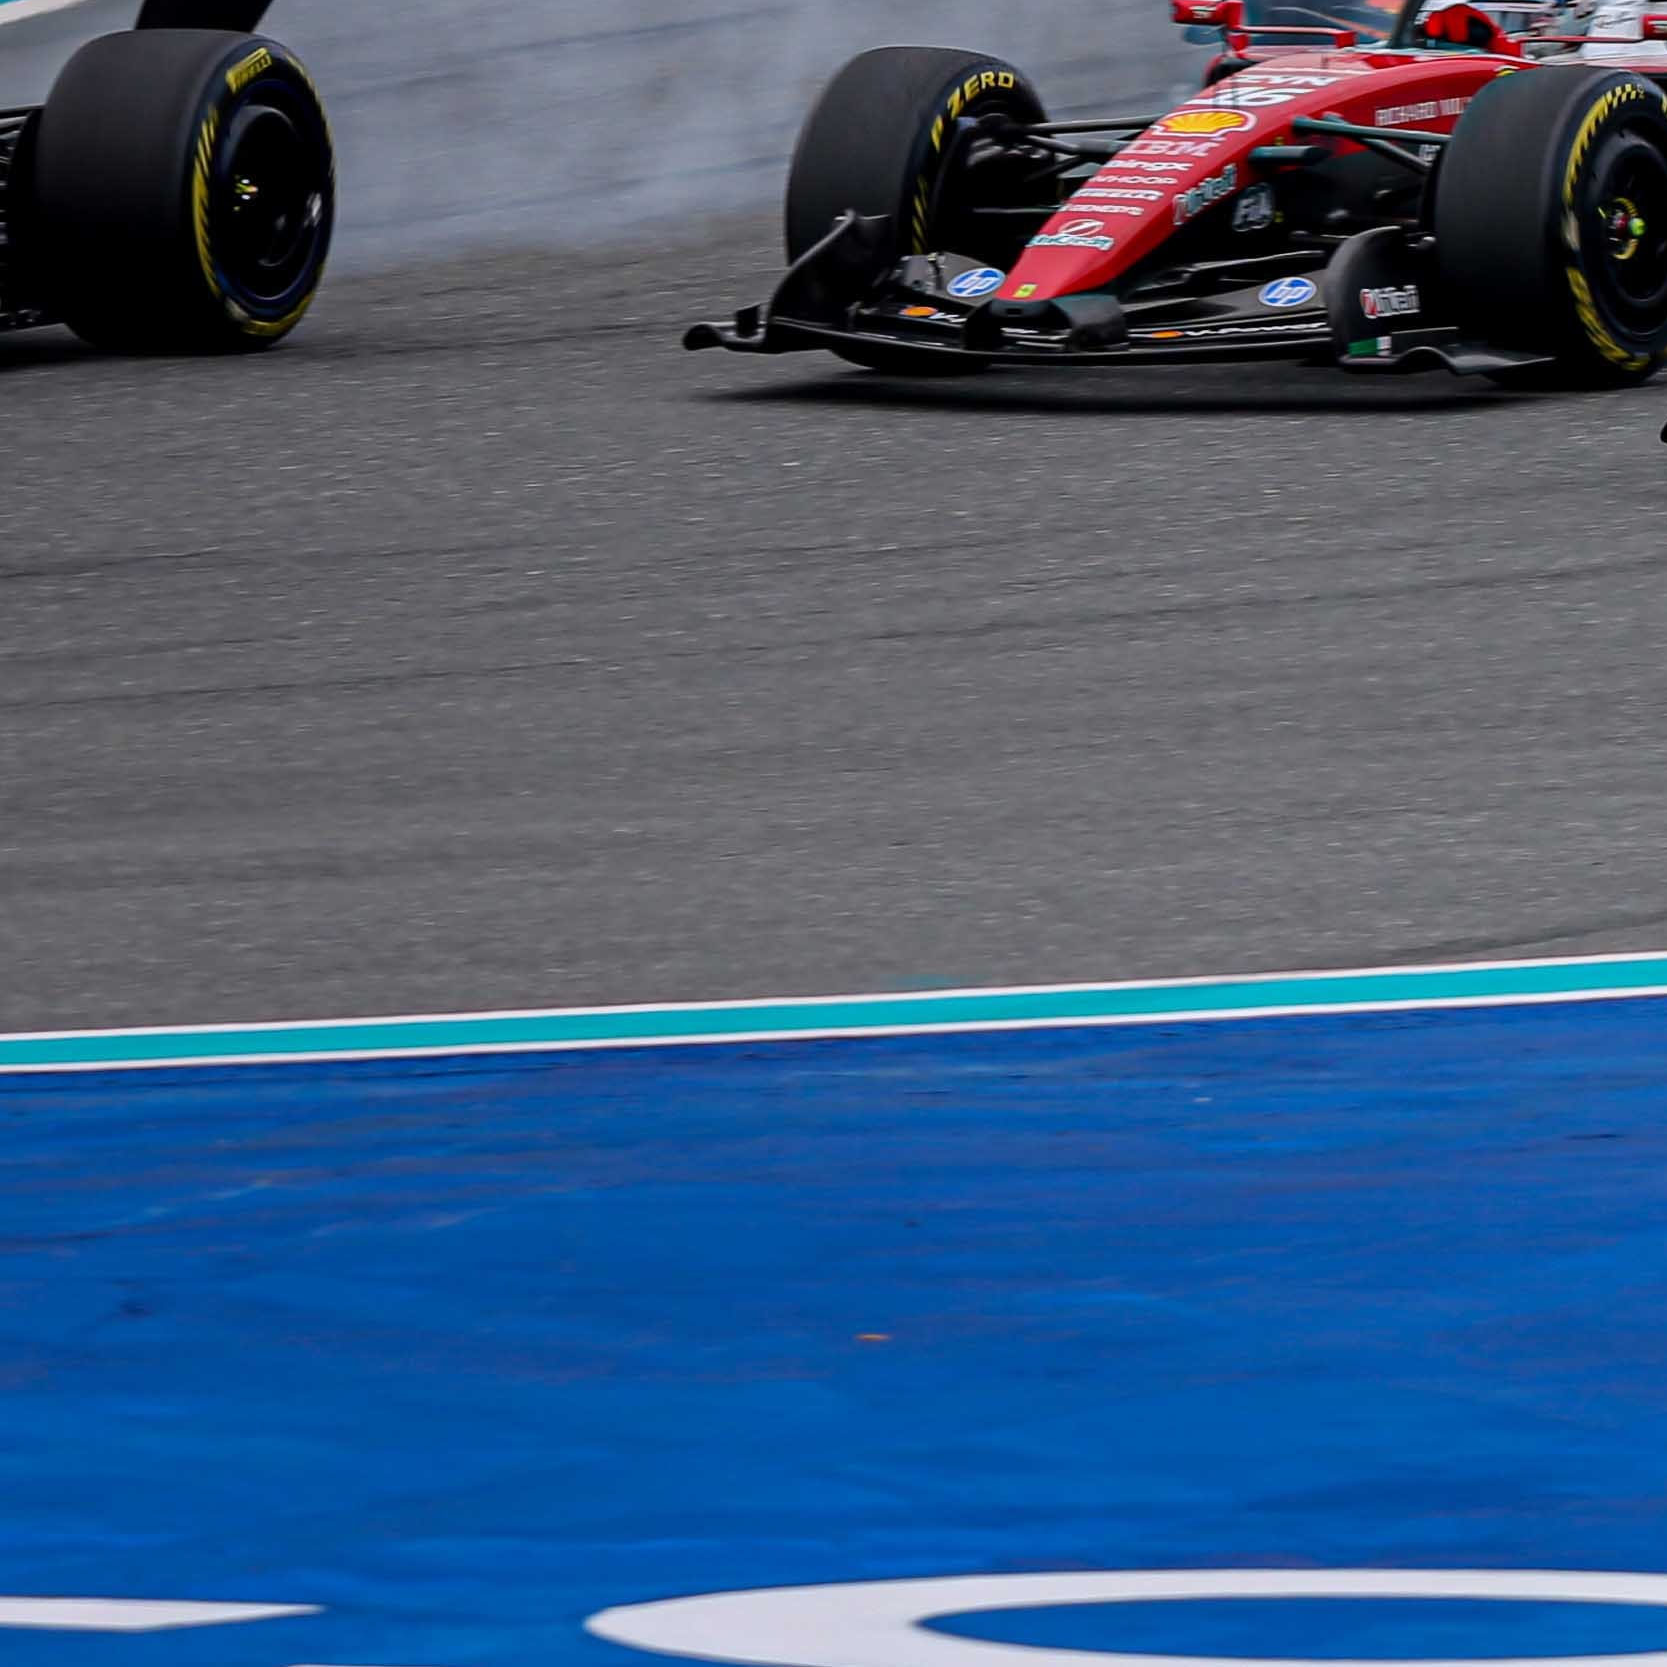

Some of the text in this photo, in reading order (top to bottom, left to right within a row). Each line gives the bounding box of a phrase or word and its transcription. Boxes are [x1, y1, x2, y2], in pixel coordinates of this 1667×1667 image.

[947, 71, 1015, 121] ZERO
[1183, 86, 1317, 107] 16
[1113, 140, 1223, 157] IBM
